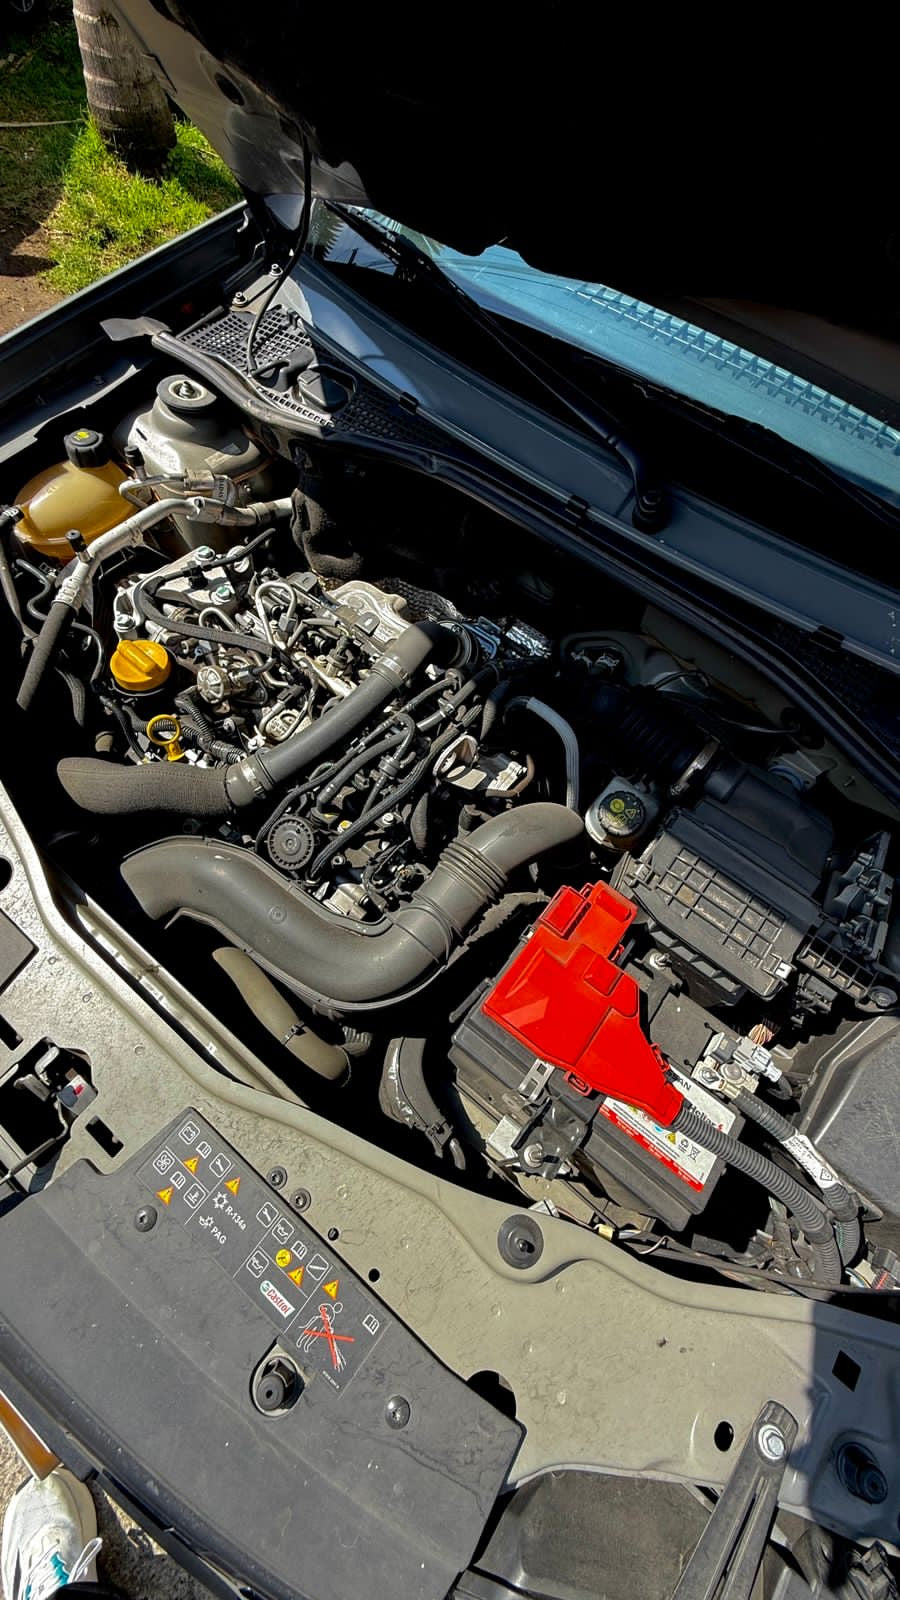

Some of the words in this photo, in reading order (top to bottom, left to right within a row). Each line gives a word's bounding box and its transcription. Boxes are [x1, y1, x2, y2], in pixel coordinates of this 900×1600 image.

[224, 1204, 247, 1231] R-134a
[210, 1225, 227, 1244] PAG
[266, 1288, 291, 1314] Castrol
